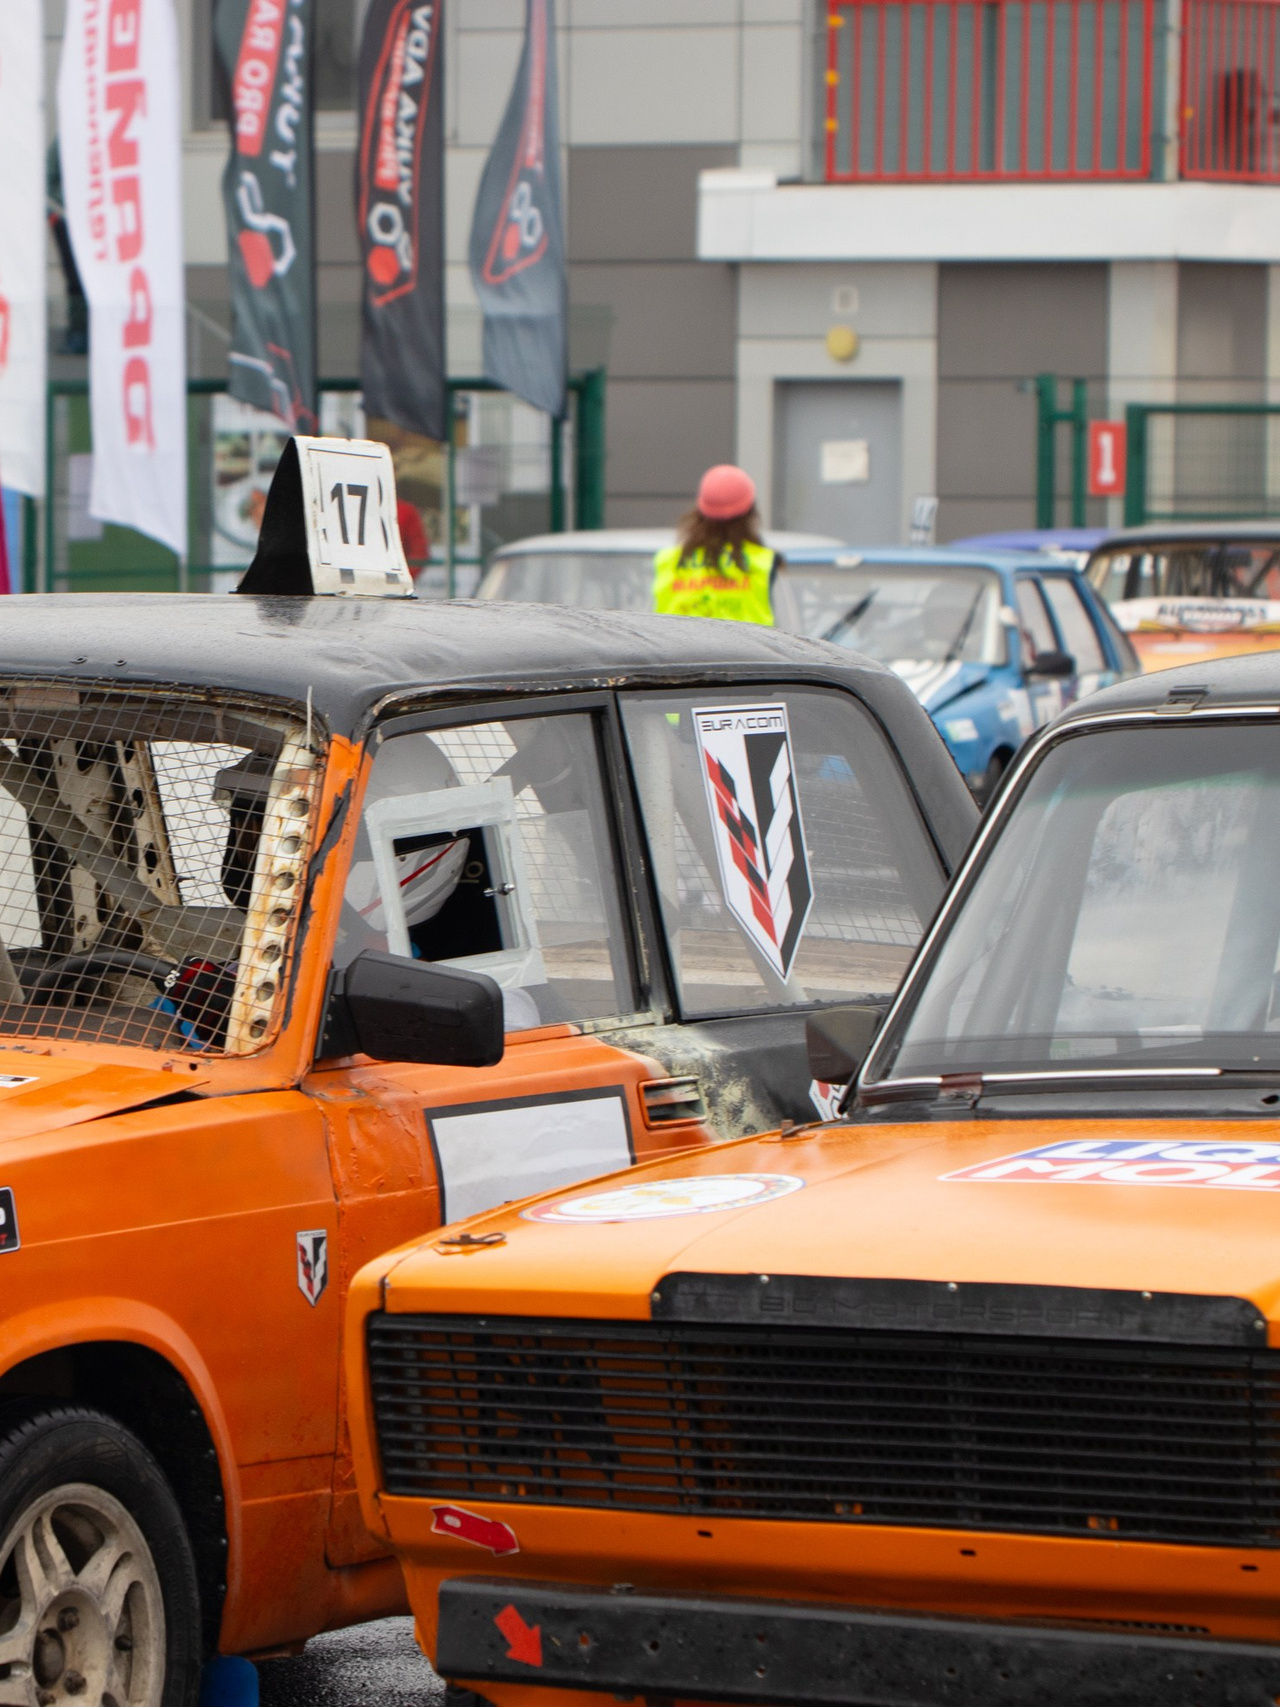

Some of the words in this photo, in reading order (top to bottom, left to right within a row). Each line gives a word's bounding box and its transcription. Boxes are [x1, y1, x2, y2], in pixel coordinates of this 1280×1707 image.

[330, 482, 369, 546] 17
[701, 716, 783, 732] EURACOM
[1034, 1141, 1280, 1164] LIQ
